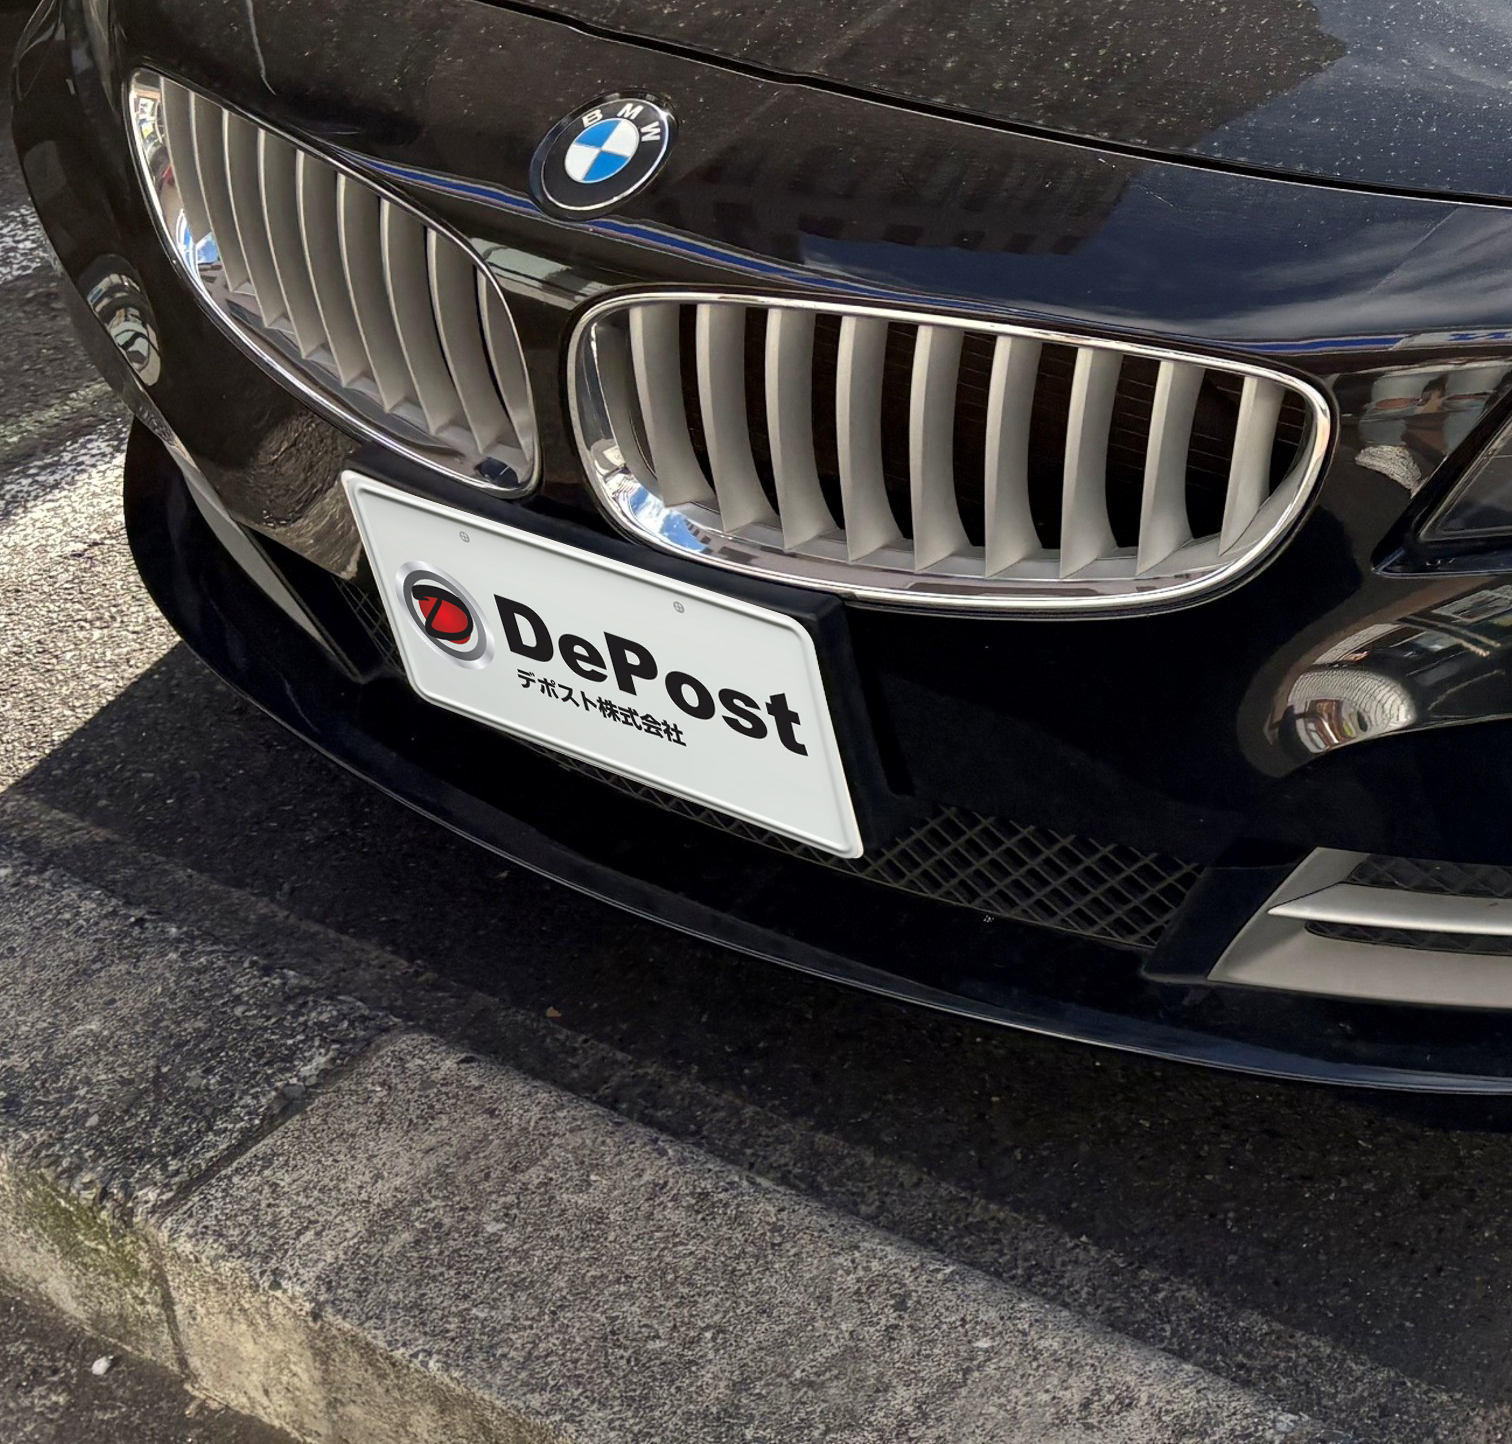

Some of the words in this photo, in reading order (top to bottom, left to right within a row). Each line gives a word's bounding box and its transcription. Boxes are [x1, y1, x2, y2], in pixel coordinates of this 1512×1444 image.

[582, 103, 661, 142] BMW
[493, 593, 809, 756] DePost
[517, 669, 687, 747] デポスト株式会社
